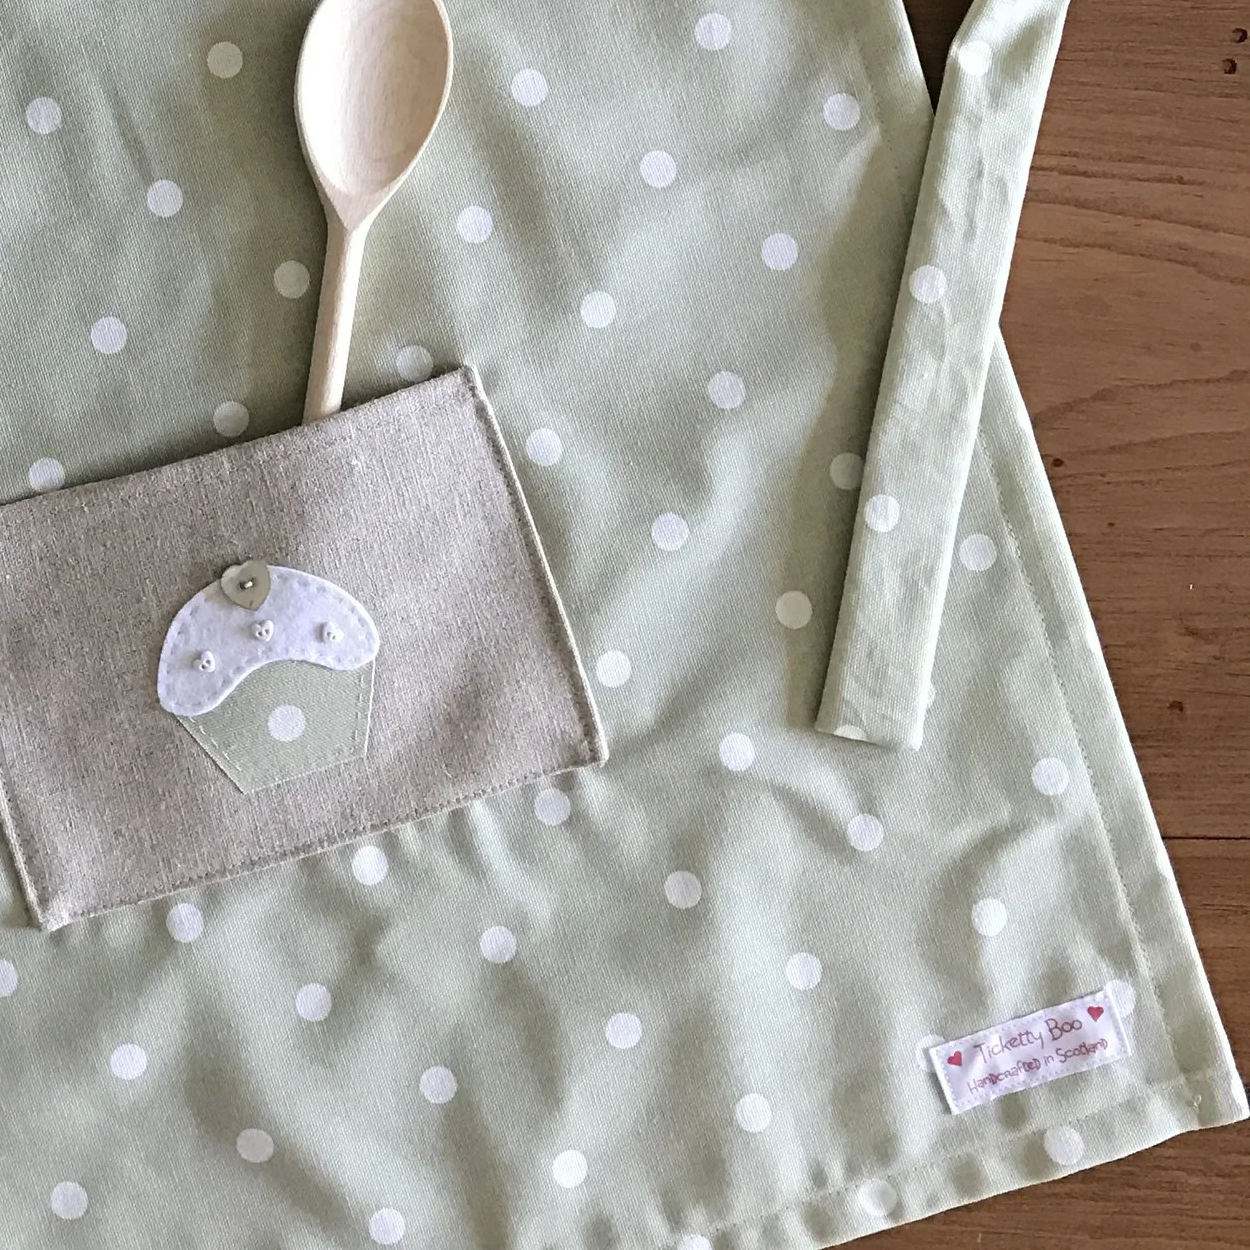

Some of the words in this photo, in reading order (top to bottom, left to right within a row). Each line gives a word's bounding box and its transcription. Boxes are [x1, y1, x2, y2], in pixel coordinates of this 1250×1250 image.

[972, 1030, 1044, 1063] Ticketty
[1045, 1018, 1082, 1041] Boo
[1044, 1056, 1054, 1067] in
